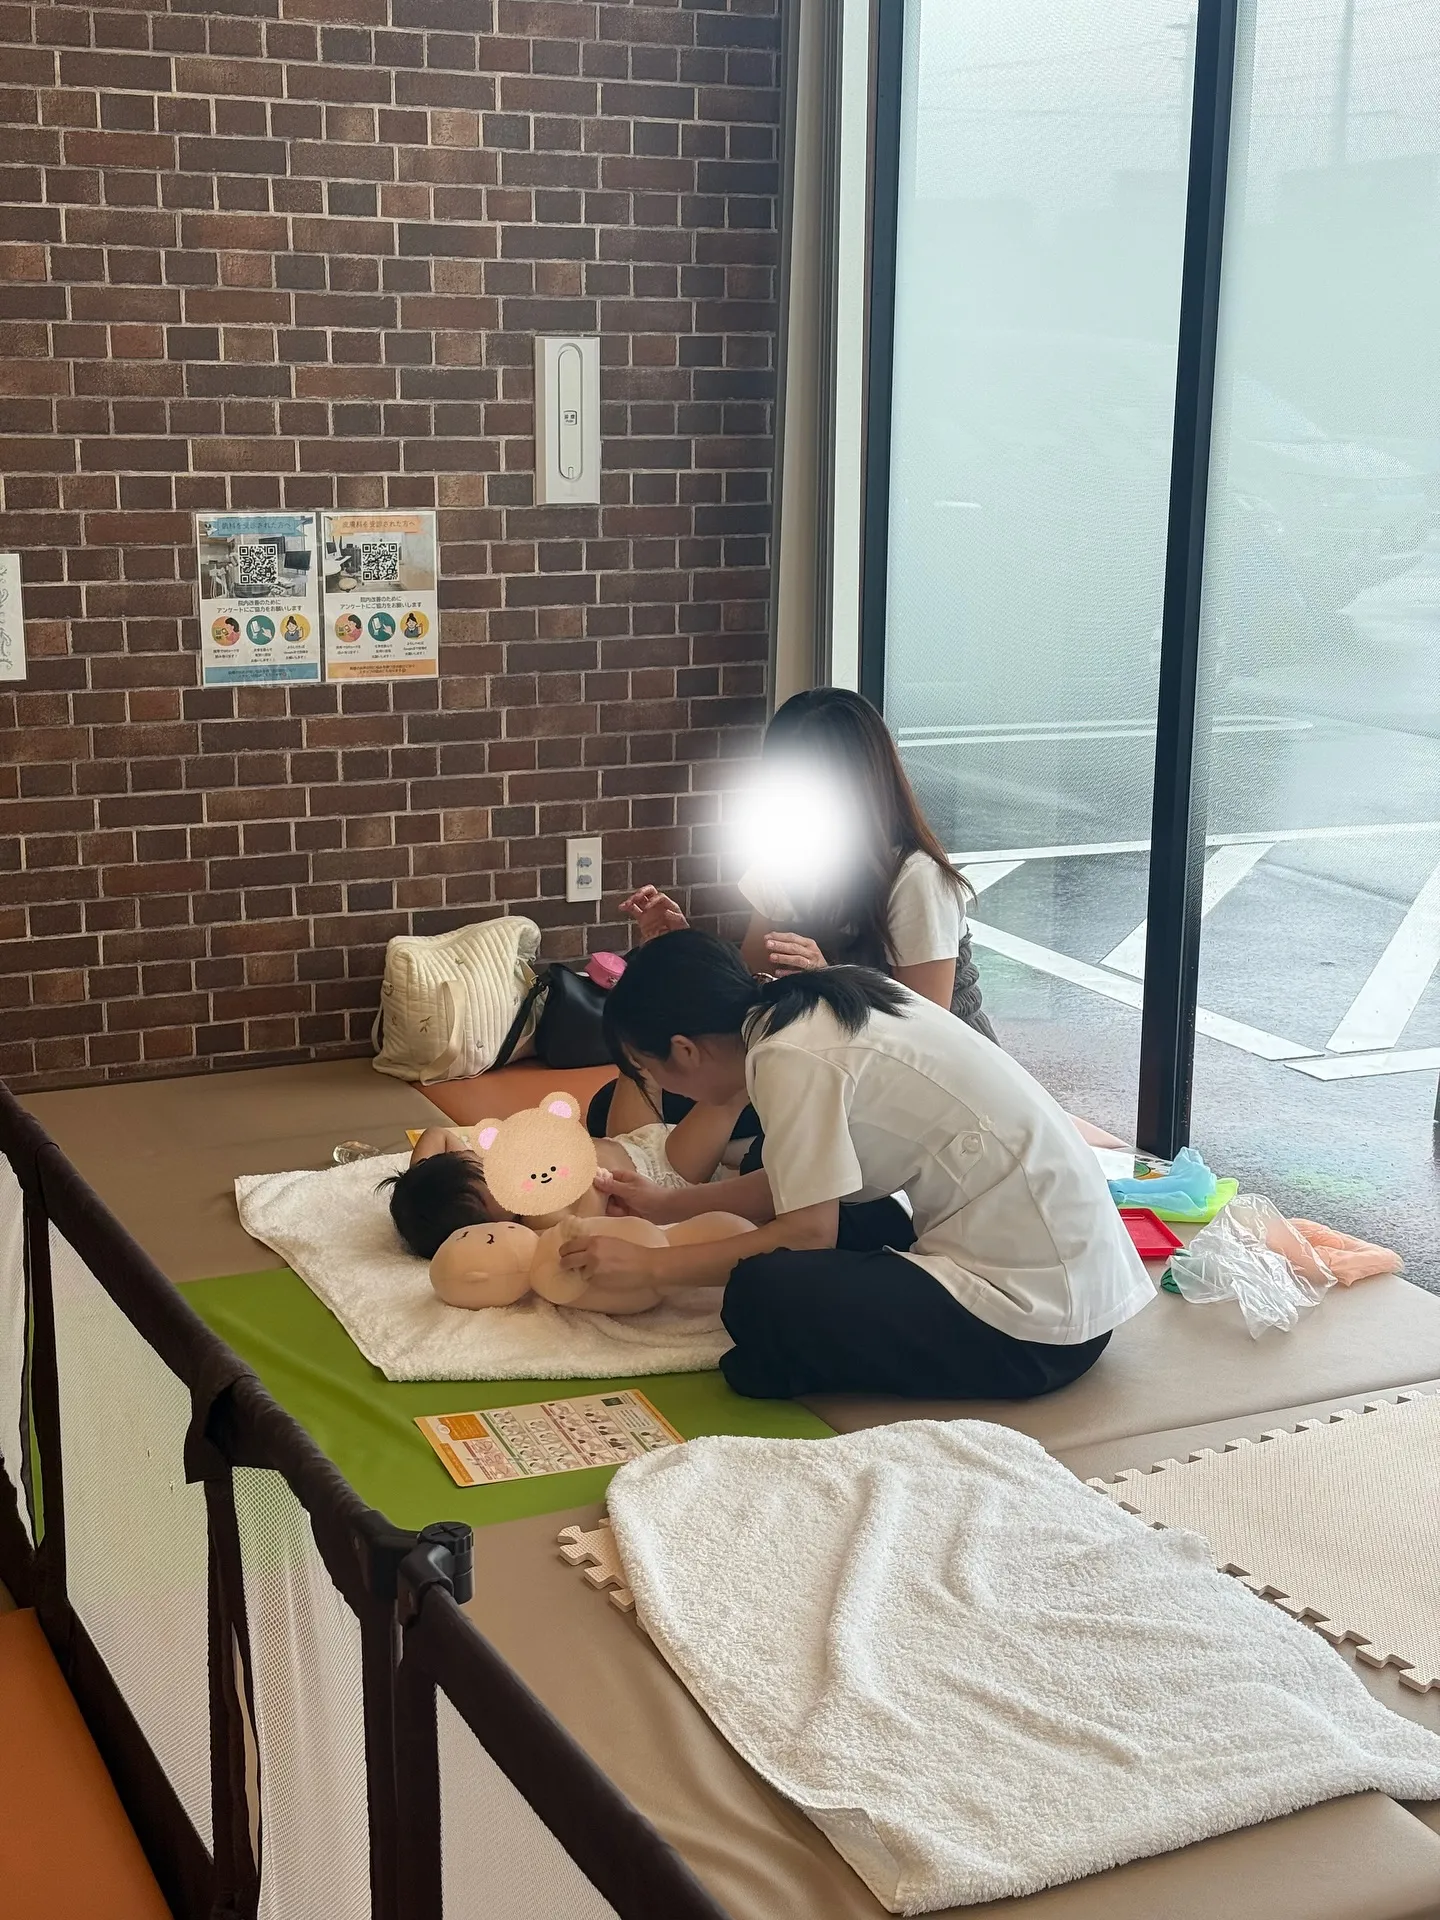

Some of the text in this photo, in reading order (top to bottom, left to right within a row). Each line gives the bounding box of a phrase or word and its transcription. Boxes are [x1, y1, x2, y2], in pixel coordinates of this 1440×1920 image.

[217, 605, 302, 613] アンケートにご協力をお願いします
[340, 602, 422, 610] アンケートにご協力をお願いします
